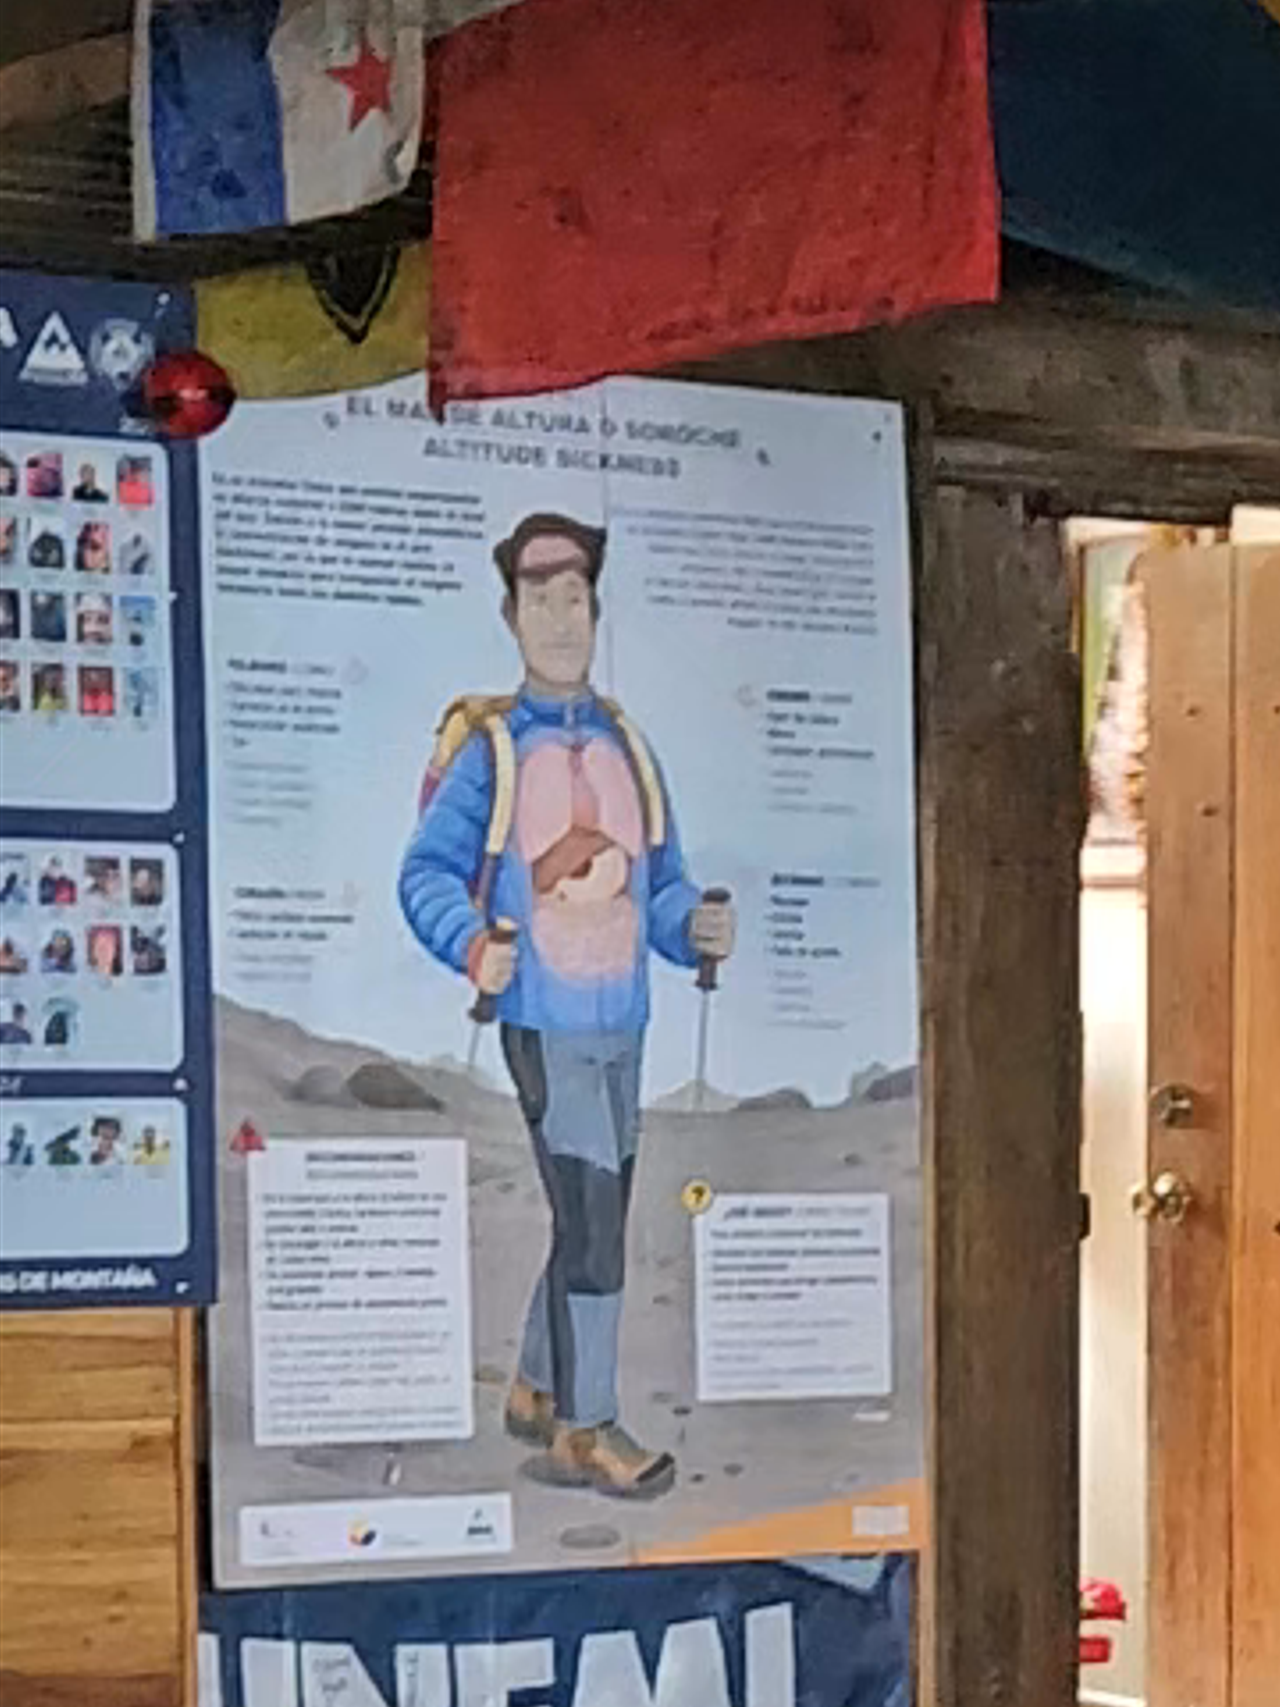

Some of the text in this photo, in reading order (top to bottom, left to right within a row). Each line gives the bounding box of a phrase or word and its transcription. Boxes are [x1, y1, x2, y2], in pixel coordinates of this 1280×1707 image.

[345, 395, 377, 416] EL
[489, 409, 592, 436] ALTURA
[626, 421, 742, 449] SOROCHE
[422, 436, 548, 469] ALTITUDE
